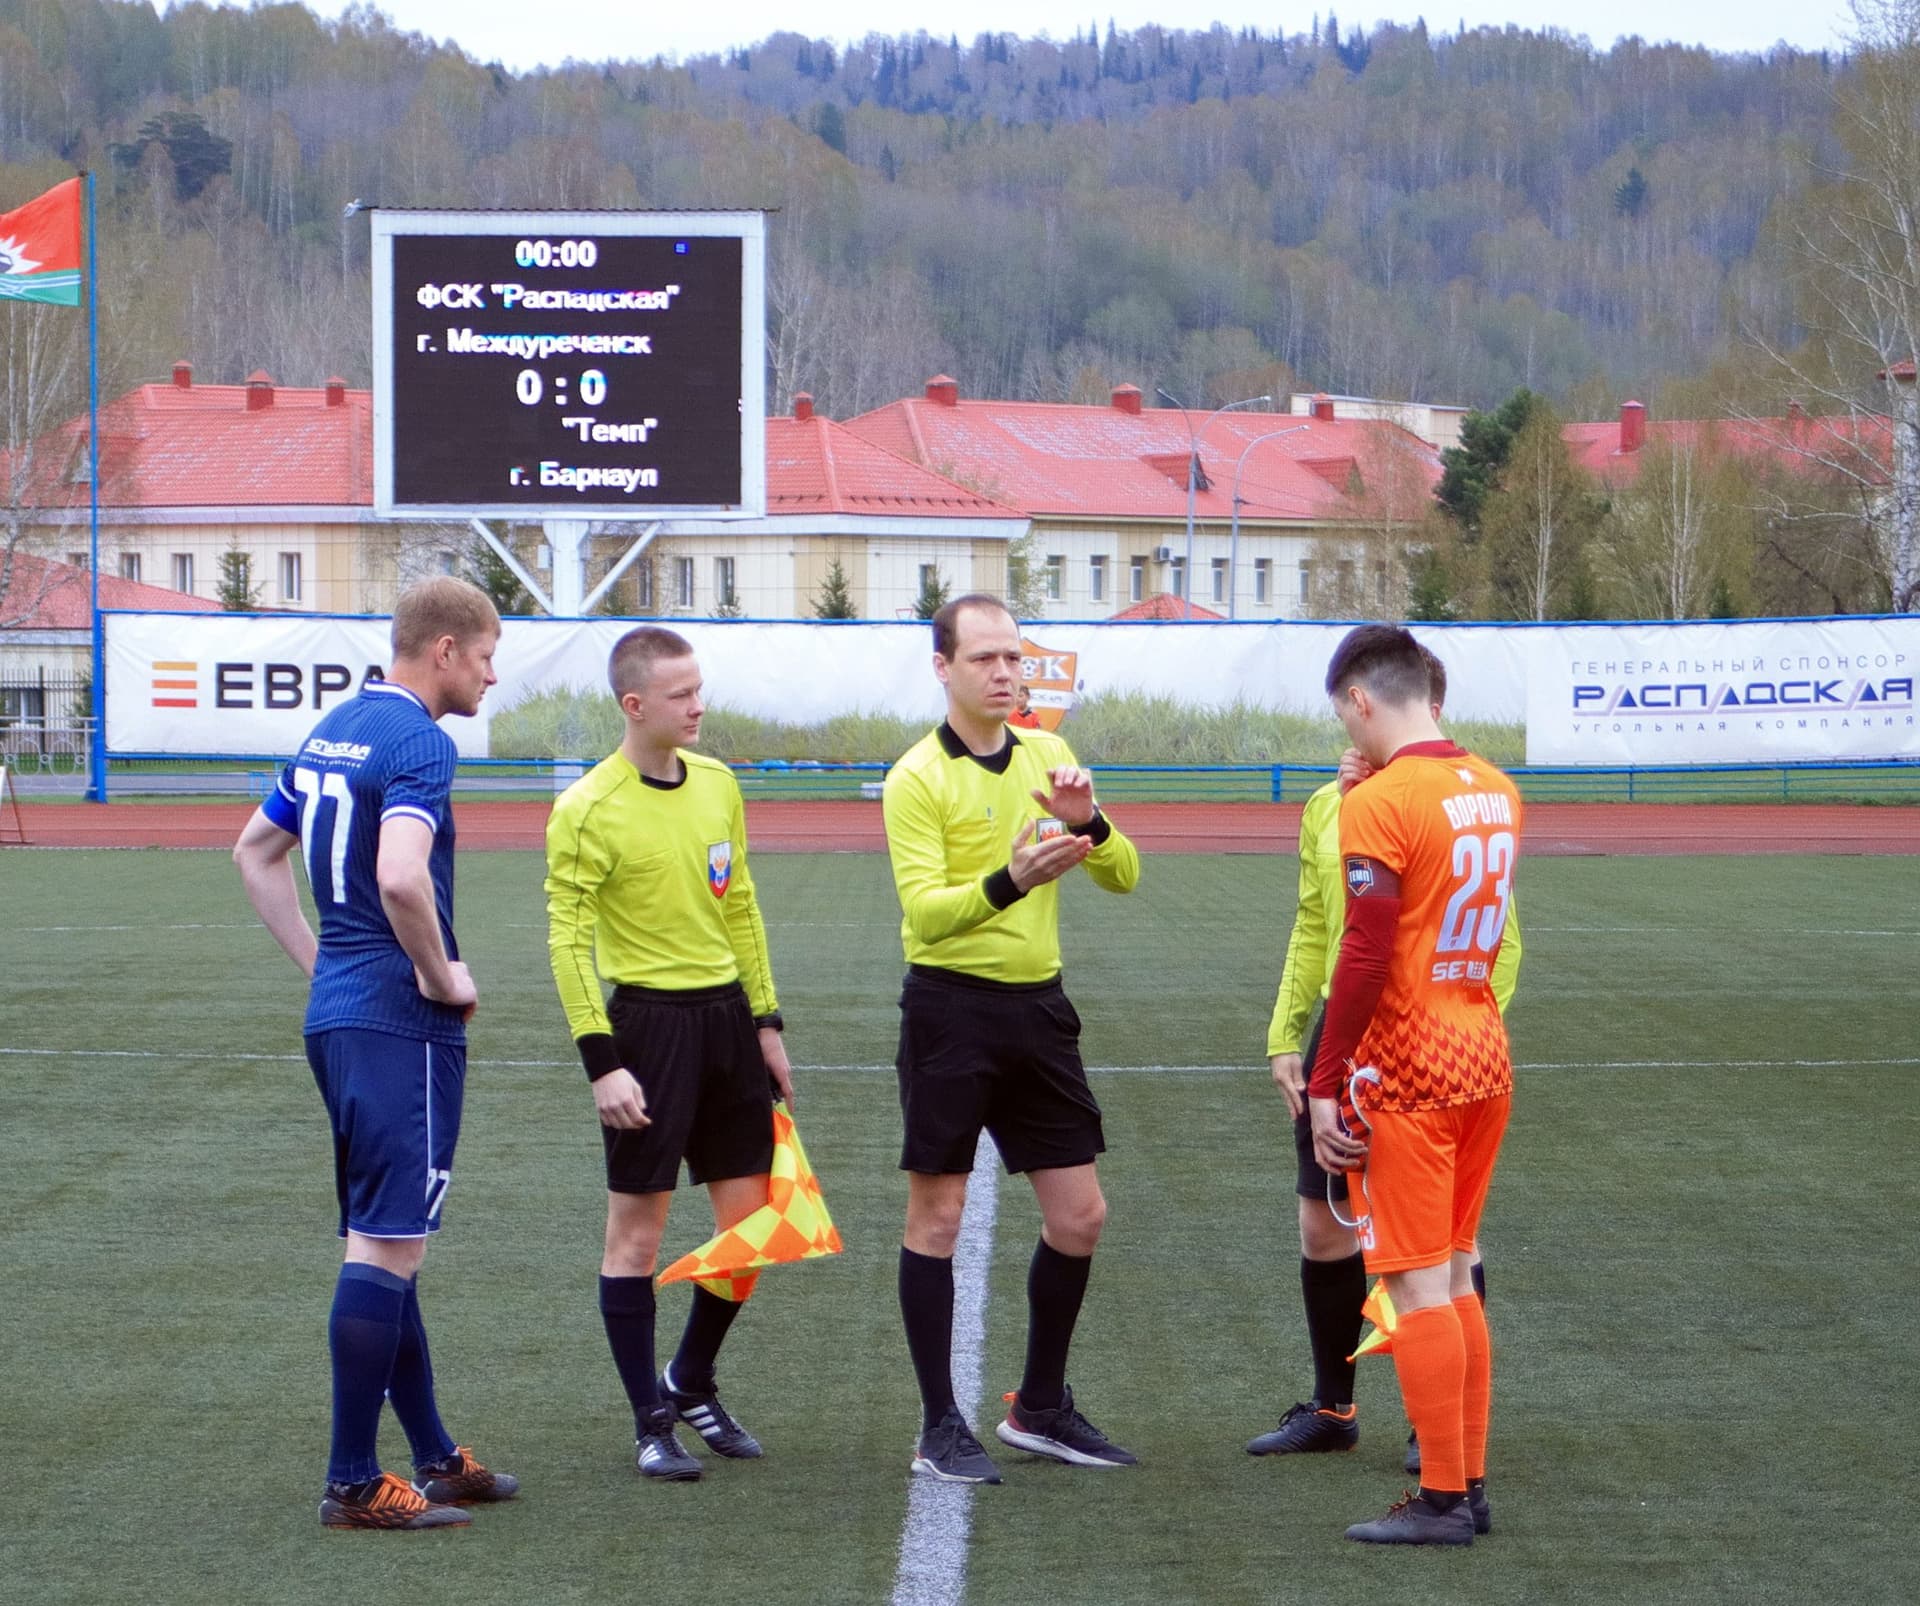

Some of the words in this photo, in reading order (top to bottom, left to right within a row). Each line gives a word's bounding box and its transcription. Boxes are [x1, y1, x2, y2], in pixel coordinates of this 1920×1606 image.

[515, 240, 598, 268] 00:00
[416, 284, 486, 309] ФСК
[491, 284, 680, 312] "Распадская"
[416, 335, 437, 352] г.
[447, 328, 652, 359] Междуреченск
[516, 369, 543, 405] 0
[580, 369, 607, 405] 0
[562, 417, 658, 443] "Темп"
[510, 466, 531, 486] г.
[540, 461, 658, 493] Барнаул
[1571, 657, 1764, 675] ГЕНЕРАЛЬНЫЙ
[1779, 654, 1905, 671] СПОНСОР
[1573, 678, 1913, 709] РАСПАДСКАЯ
[1572, 721, 1726, 733] УГОЛЬНАЯ
[1755, 715, 1914, 730] КОМПАНИЯ
[1442, 793, 1512, 830] ВОРОНА
[294, 766, 353, 904] 77
[1436, 832, 1514, 953] 23
